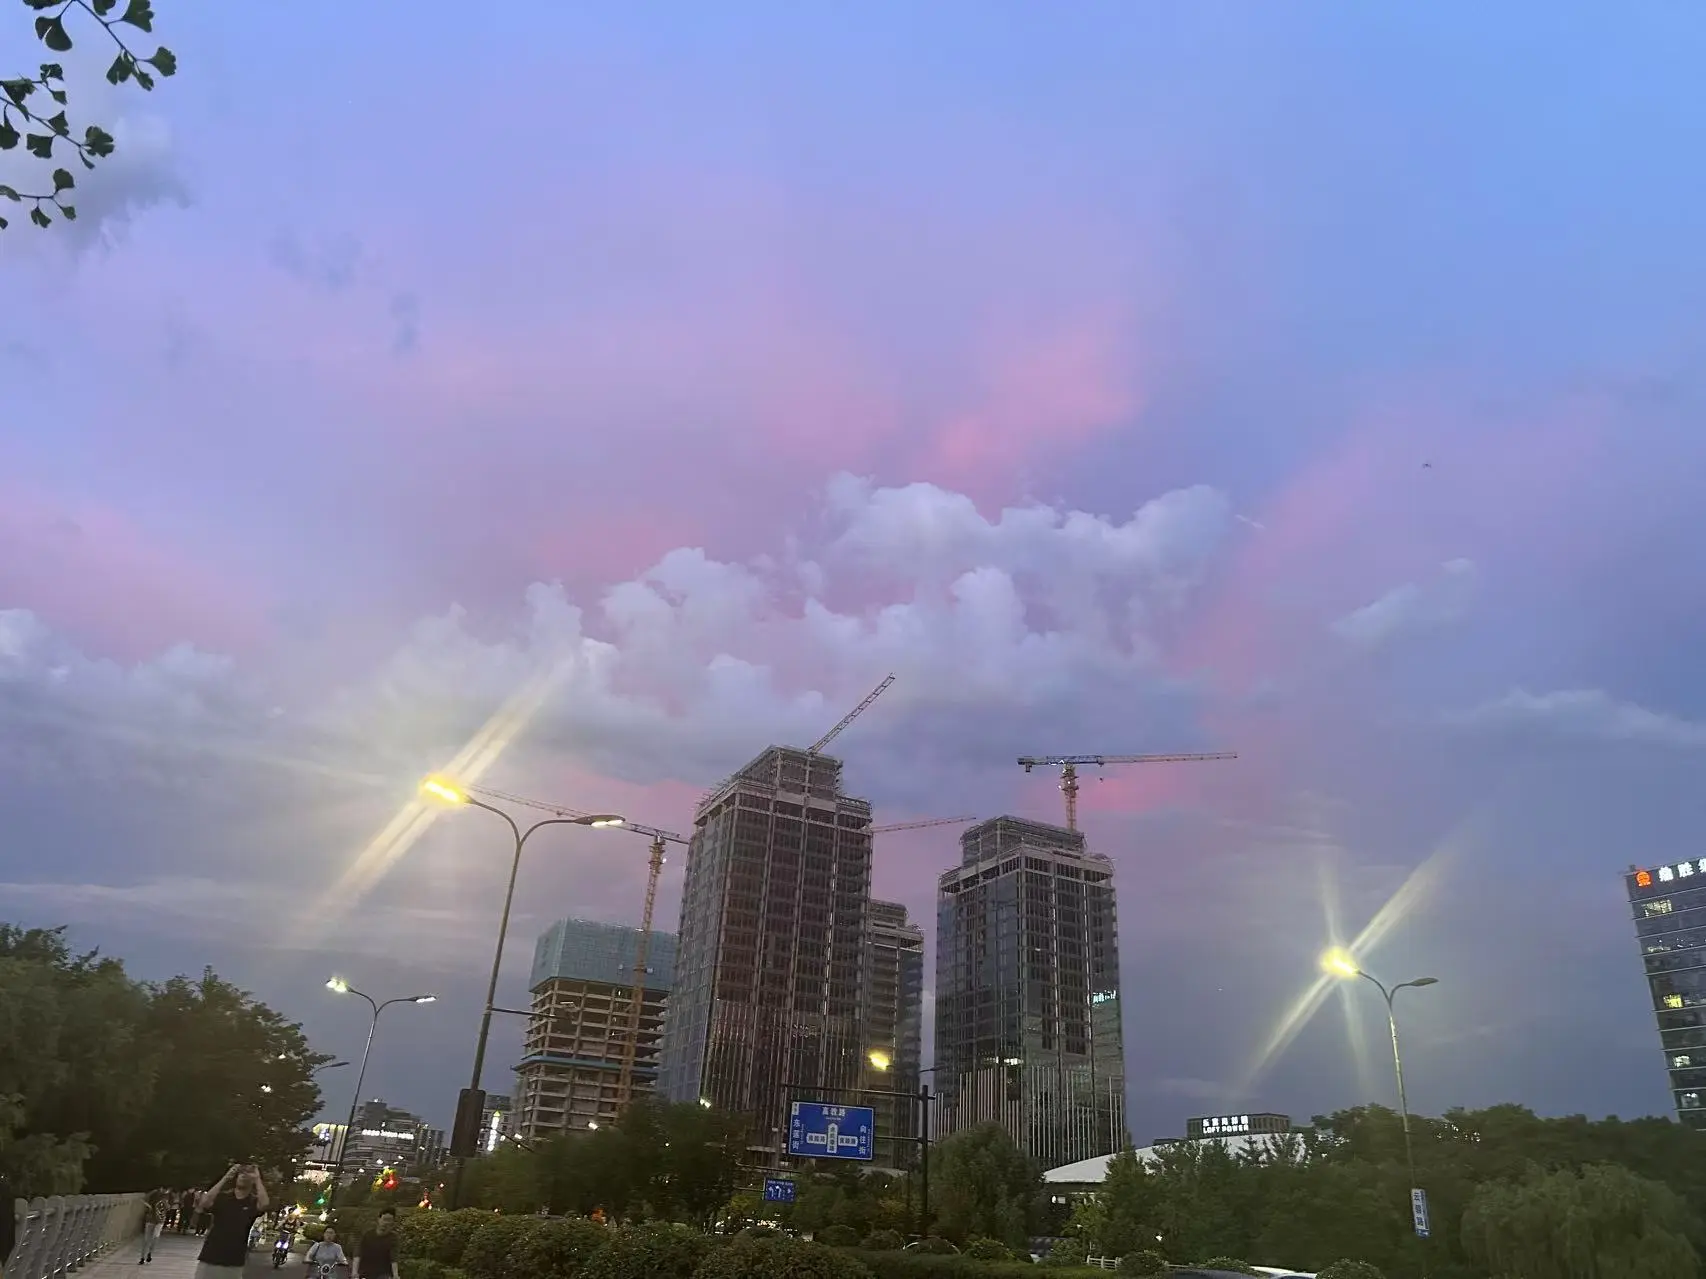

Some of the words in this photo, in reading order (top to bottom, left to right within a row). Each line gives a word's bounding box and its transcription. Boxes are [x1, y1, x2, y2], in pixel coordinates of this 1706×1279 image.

[822, 1106, 846, 1117] 高教路
[1202, 1126, 1220, 1134] LOFT
[1221, 1124, 1249, 1133] POWER
[859, 1125, 867, 1155] 向往街
